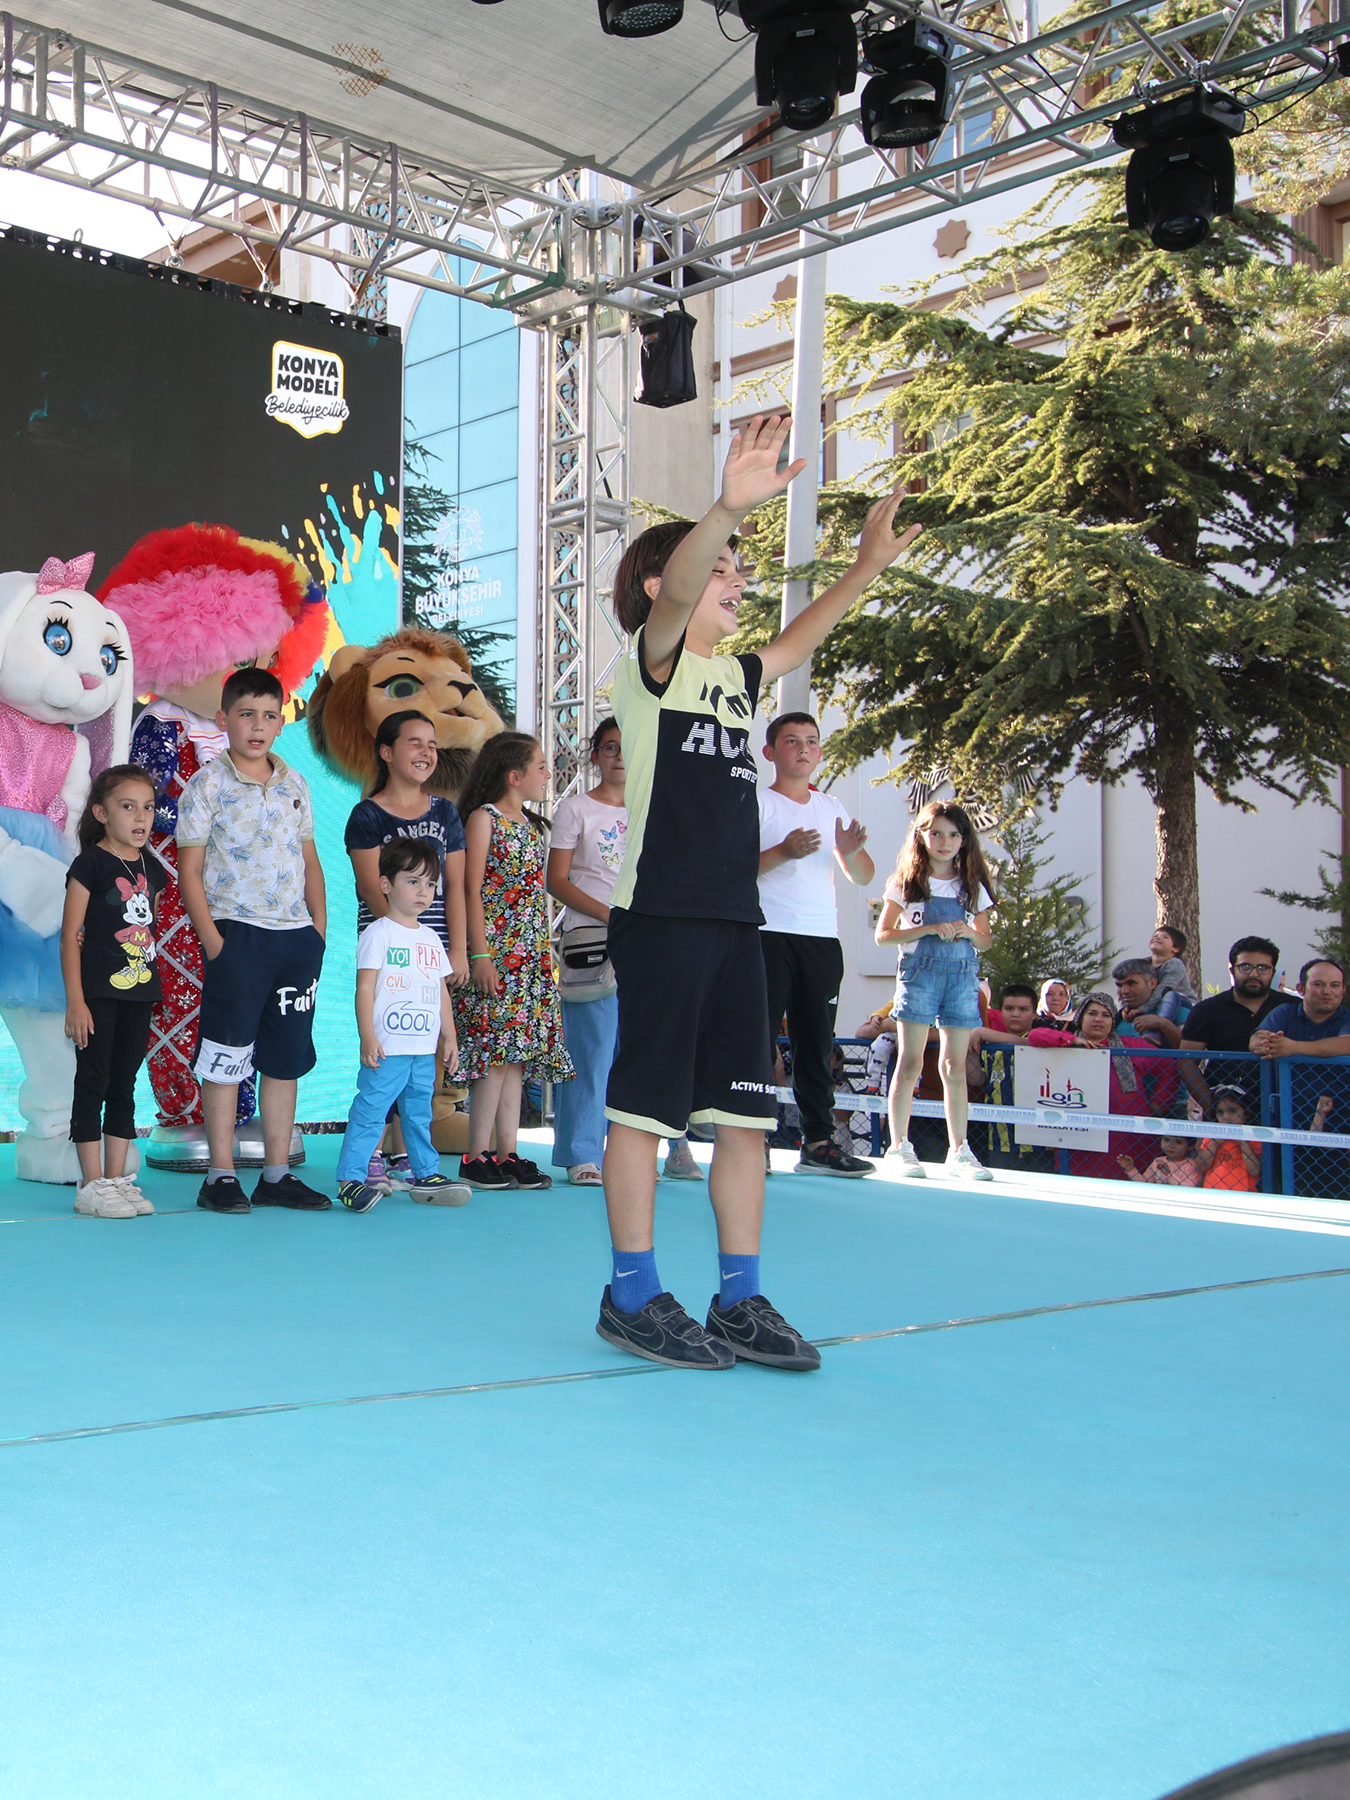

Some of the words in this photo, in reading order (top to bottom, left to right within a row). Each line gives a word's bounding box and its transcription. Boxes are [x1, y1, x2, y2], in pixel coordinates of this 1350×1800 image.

[278, 353, 339, 378] KONYA
[267, 395, 348, 425] Belediyecilik
[437, 565, 480, 588] KONYA
[133, 931, 147, 942] M
[388, 948, 409, 965] YO!
[276, 978, 319, 1015] Fait
[387, 1011, 431, 1032] COOL
[730, 1081, 764, 1093] ACTIVE
